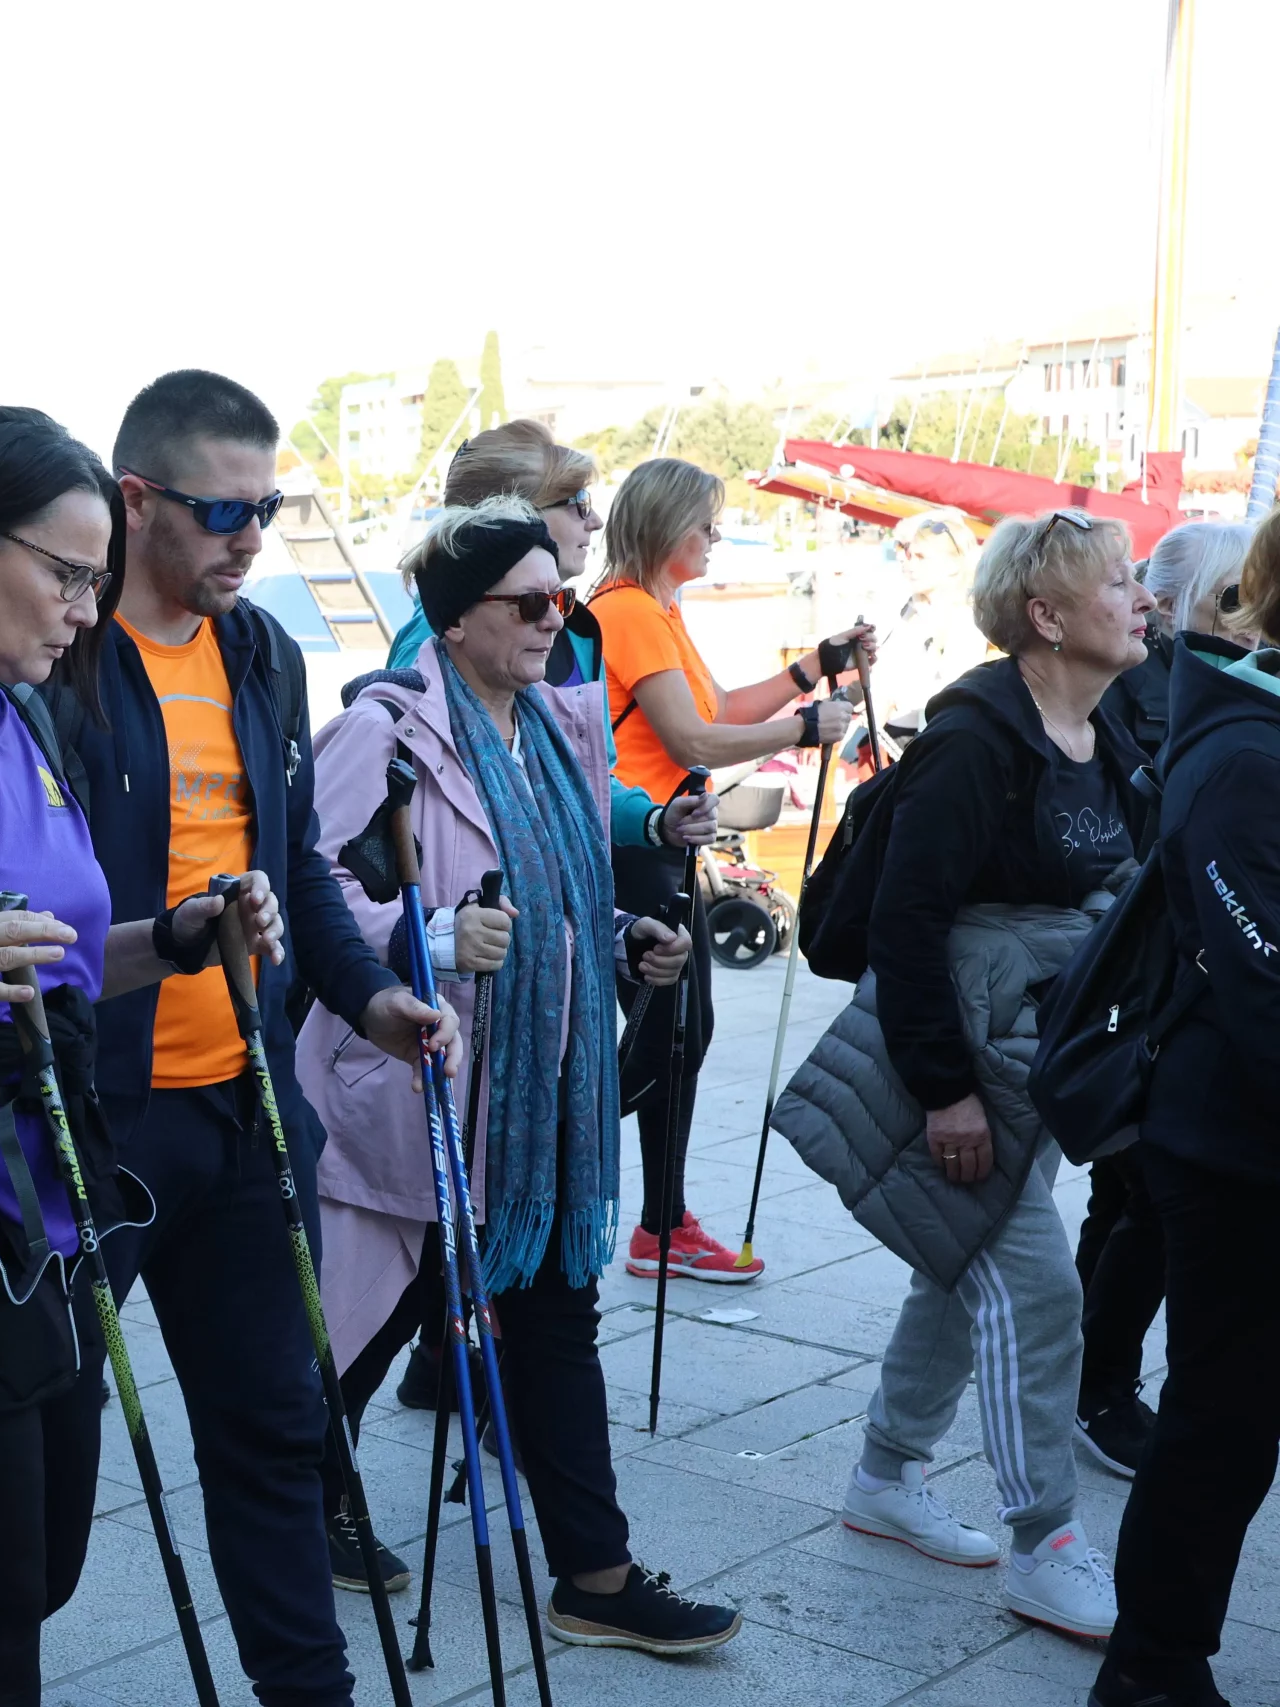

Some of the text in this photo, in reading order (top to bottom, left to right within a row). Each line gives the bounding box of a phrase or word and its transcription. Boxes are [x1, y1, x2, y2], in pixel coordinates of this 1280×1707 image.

[52, 1110, 88, 1200] newfeel
[256, 1071, 288, 1153] newfeel
[429, 1112, 457, 1262] MISTRAL
